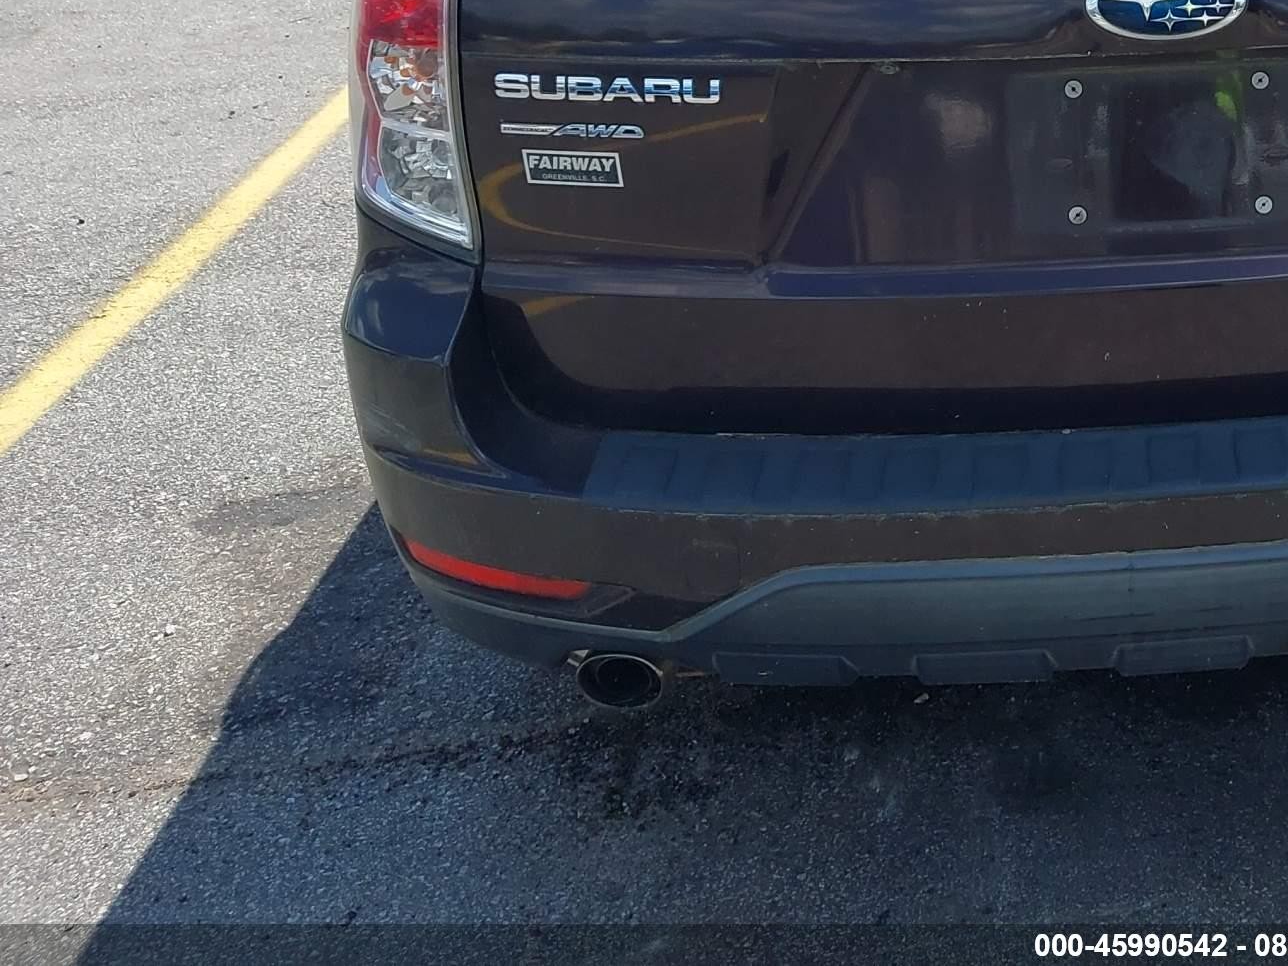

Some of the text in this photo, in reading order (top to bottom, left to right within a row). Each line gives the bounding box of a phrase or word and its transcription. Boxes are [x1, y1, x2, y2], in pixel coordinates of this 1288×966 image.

[494, 72, 721, 104] SUBARU
[552, 122, 645, 139] AWD
[528, 154, 615, 172] FAIRWAY
